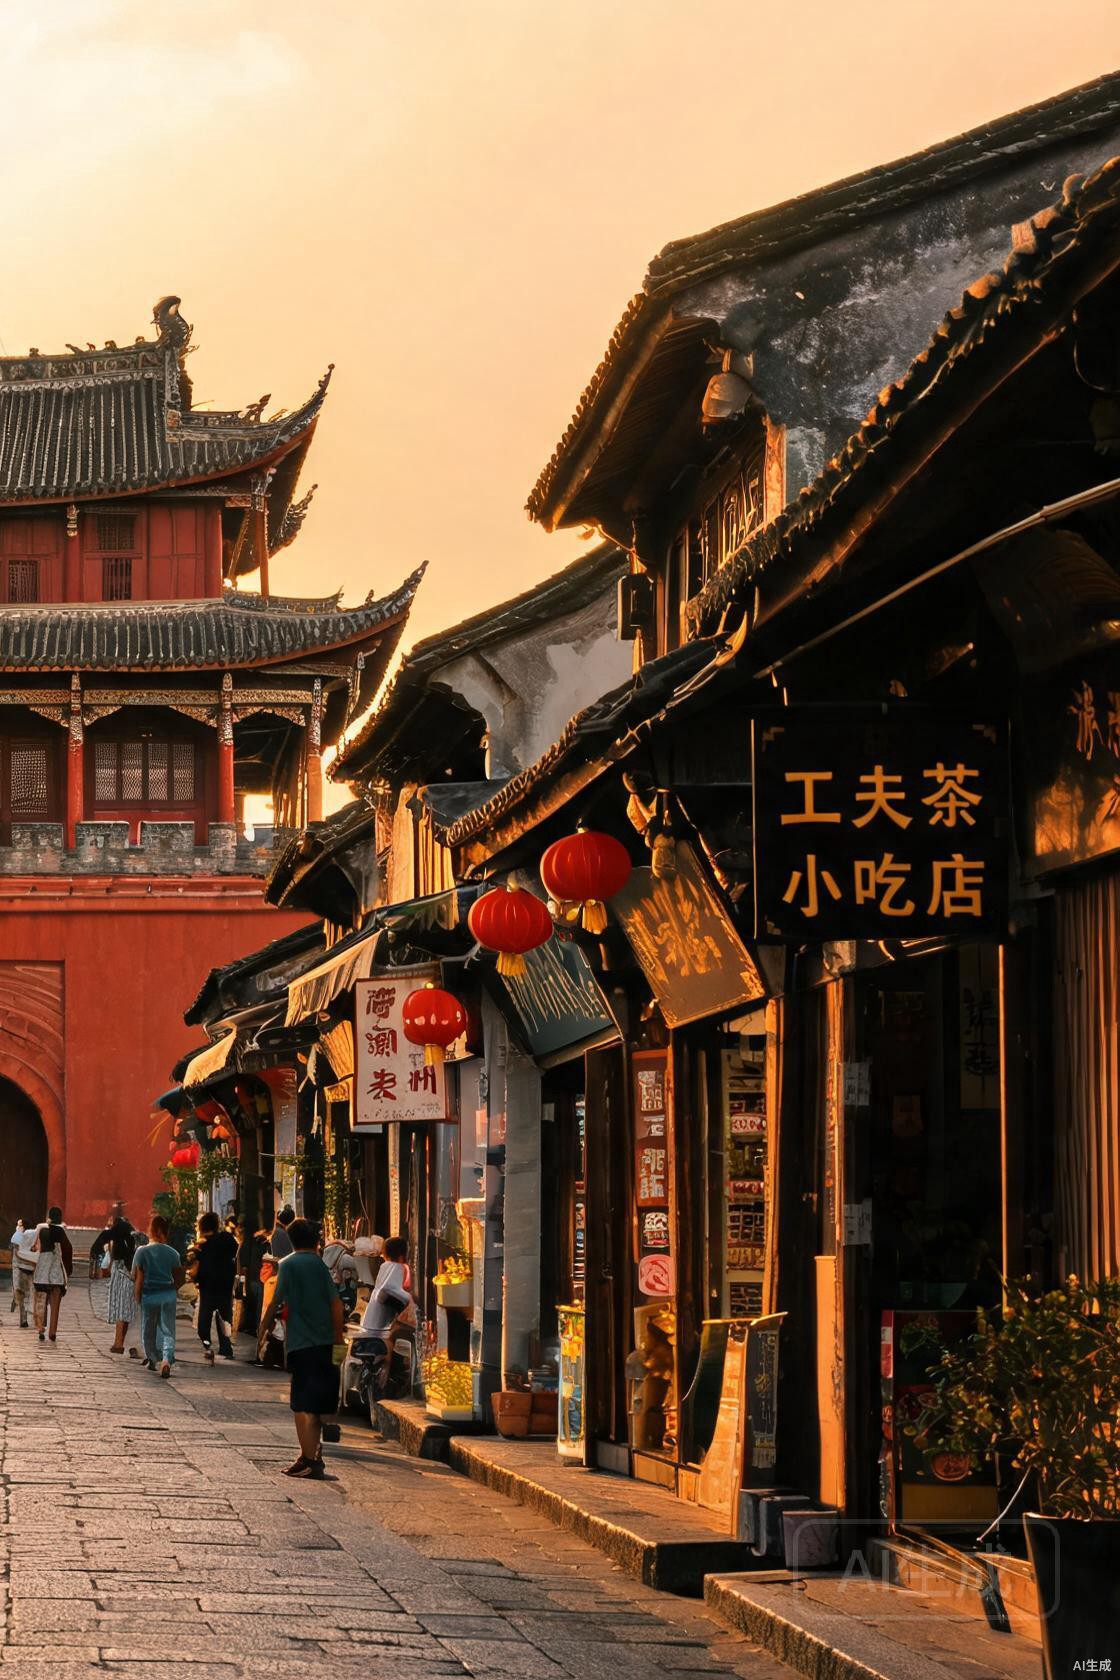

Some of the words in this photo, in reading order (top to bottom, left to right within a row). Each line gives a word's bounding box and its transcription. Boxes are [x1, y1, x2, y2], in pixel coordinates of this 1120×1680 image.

[781, 762, 982, 830] 工夫茶
[782, 852, 985, 918] 小吃店
